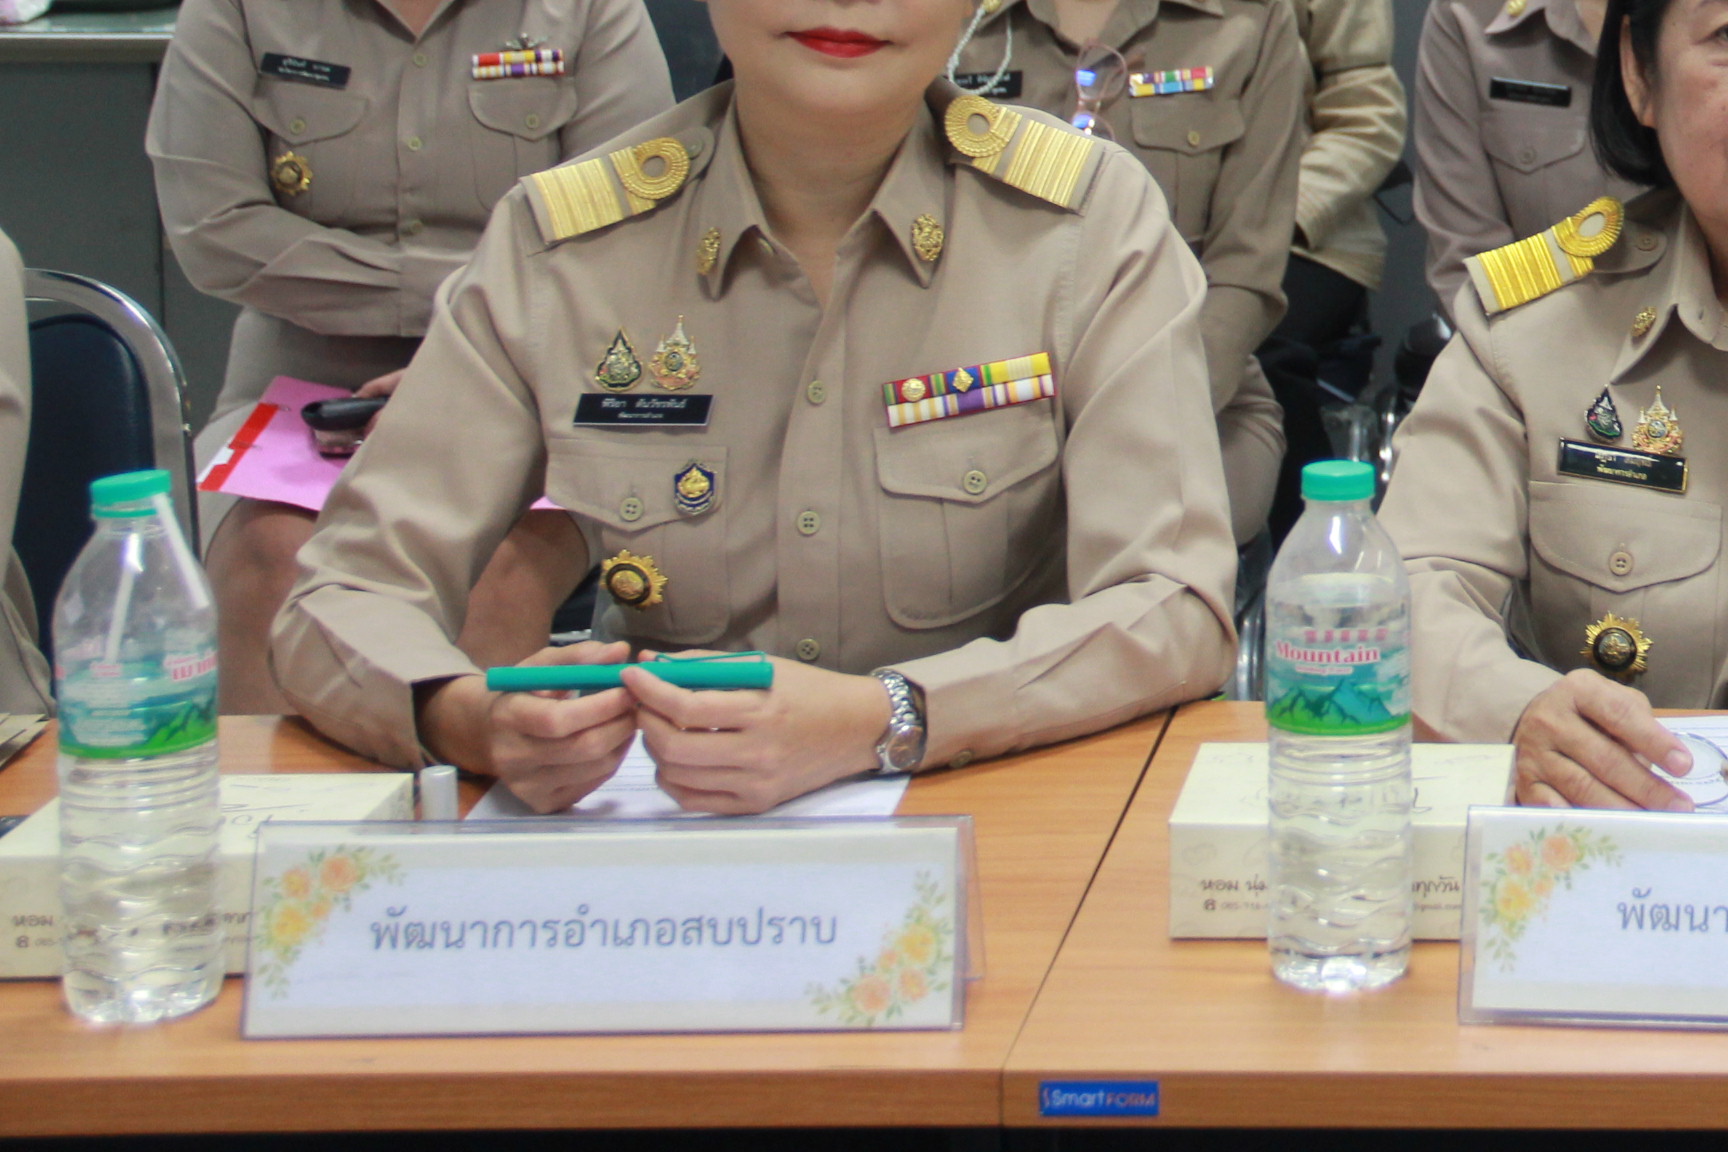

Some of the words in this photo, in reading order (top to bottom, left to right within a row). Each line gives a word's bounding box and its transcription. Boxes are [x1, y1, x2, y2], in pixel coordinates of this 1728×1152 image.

[1276, 640, 1379, 664] Mountain
[370, 905, 838, 950] พัฒนาการอำเภอสบปราบ
